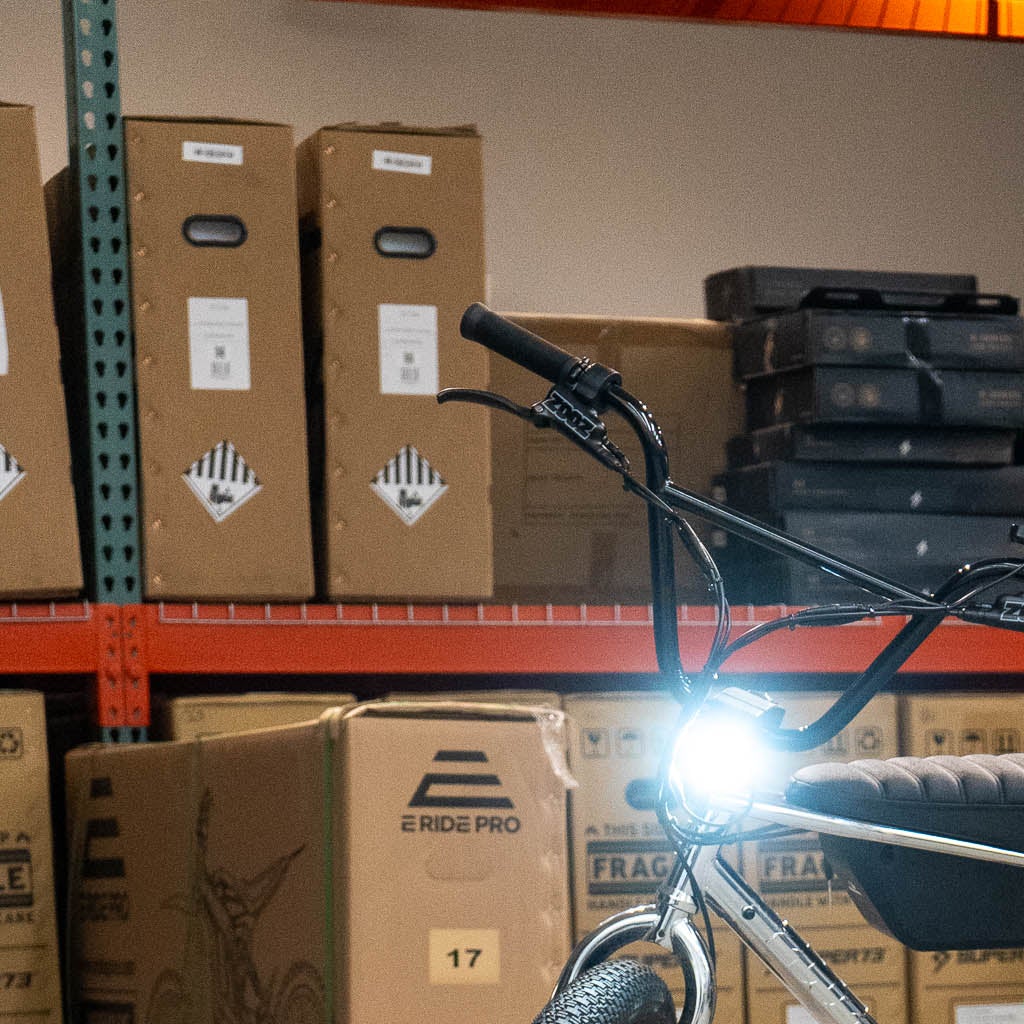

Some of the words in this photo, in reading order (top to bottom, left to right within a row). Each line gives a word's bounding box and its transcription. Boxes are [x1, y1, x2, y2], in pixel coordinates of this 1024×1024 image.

[542, 390, 597, 440] ZOOZ
[475, 815, 521, 833] PRO
[592, 855, 669, 878] FRAG
[446, 947, 483, 969] 17
